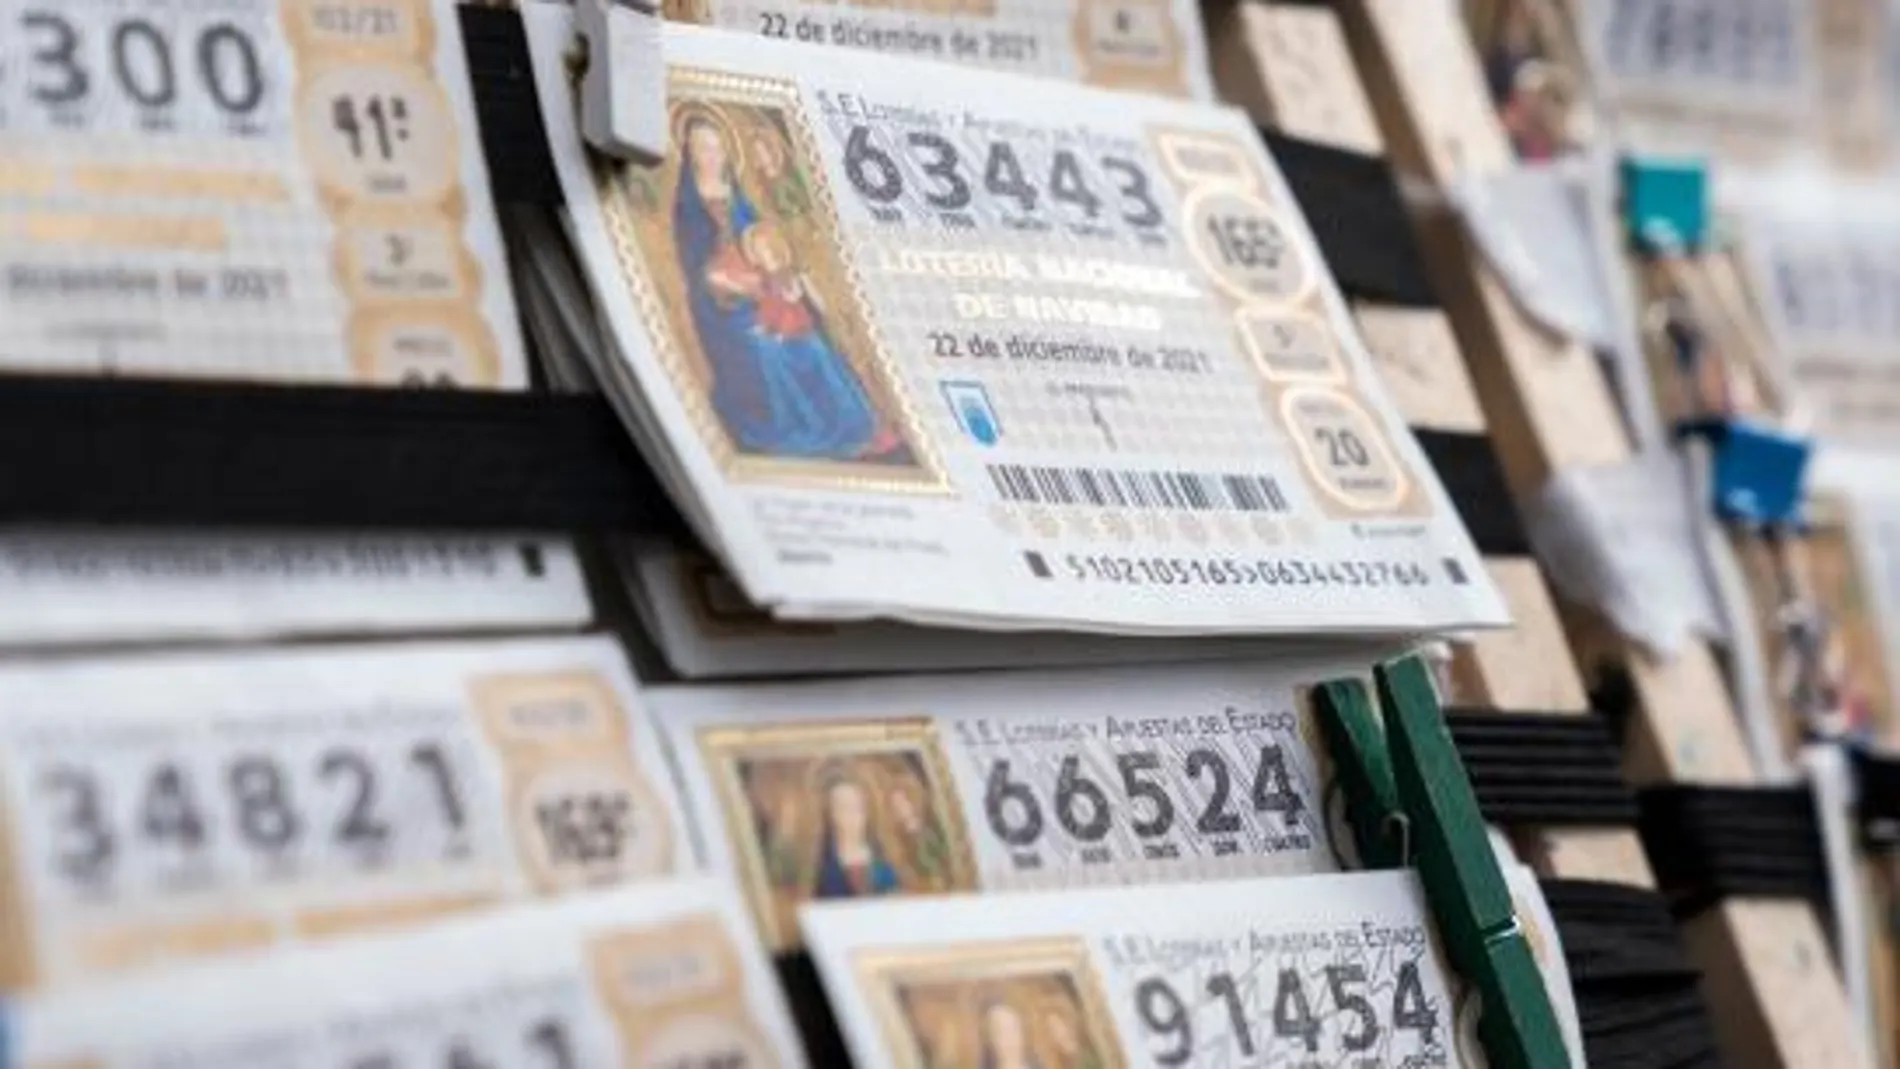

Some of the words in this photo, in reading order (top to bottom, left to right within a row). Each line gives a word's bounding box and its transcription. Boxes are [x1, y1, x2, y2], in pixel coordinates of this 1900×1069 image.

[0, 13, 264, 113] 300
[758, 11, 790, 39] 22
[796, 17, 824, 43] de
[831, 17, 943, 53] diciembre
[949, 29, 980, 55] de
[844, 124, 1163, 228] 63443
[926, 330, 960, 359] 22
[966, 331, 1001, 359] de
[1005, 333, 1121, 367] diciembre
[1126, 344, 1157, 369] de
[1158, 346, 1214, 376] 2021
[951, 291, 1009, 322] DE
[1313, 426, 1371, 467] 20
[36, 740, 468, 882] 34821
[984, 743, 1305, 847] 66524
[1134, 959, 1440, 1069] 91454
